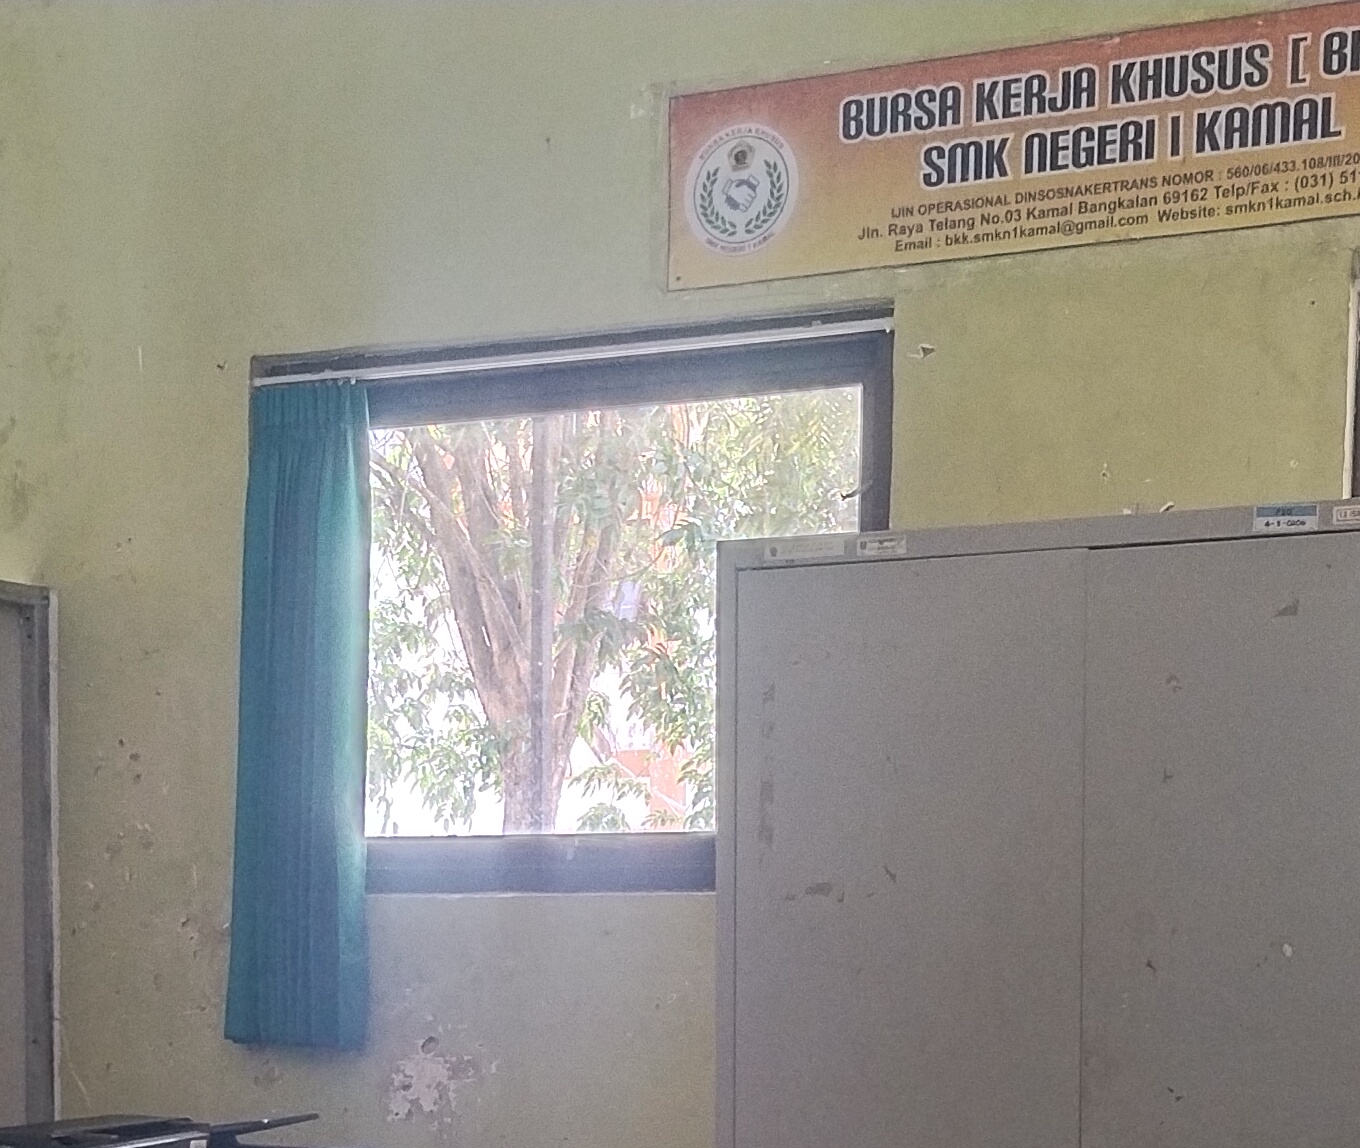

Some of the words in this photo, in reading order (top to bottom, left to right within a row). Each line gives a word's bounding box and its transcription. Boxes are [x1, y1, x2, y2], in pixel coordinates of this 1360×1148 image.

[842, 85, 962, 141] BURSA
[975, 66, 1097, 123] KERJA
[1110, 43, 1271, 105] KHUSUS
[921, 137, 1010, 188] SMK
[1024, 118, 1157, 176] NEGERI
[1194, 96, 1343, 154] KAMAL
[857, 226, 884, 241] Jln.
[887, 221, 925, 239] Raya
[929, 216, 976, 233] Telang
[980, 208, 1023, 227] No.03
[1026, 201, 1074, 221] Kamal
[1078, 193, 1159, 217] Bangkalan
[1162, 187, 1208, 206] 69162
[1213, 180, 1280, 202] Telp/Fax
[1294, 171, 1335, 194] (031)
[891, 205, 915, 220] IJIN
[917, 193, 1012, 217] OPERASIONAL
[1014, 176, 1159, 205] DINSOSNAKERTRANS
[1161, 169, 1215, 188] NOMOR
[894, 236, 933, 252] Email
[944, 214, 1149, 248] bkk.smkn1kamal@gmail.com
[1157, 205, 1221, 223] Website:
